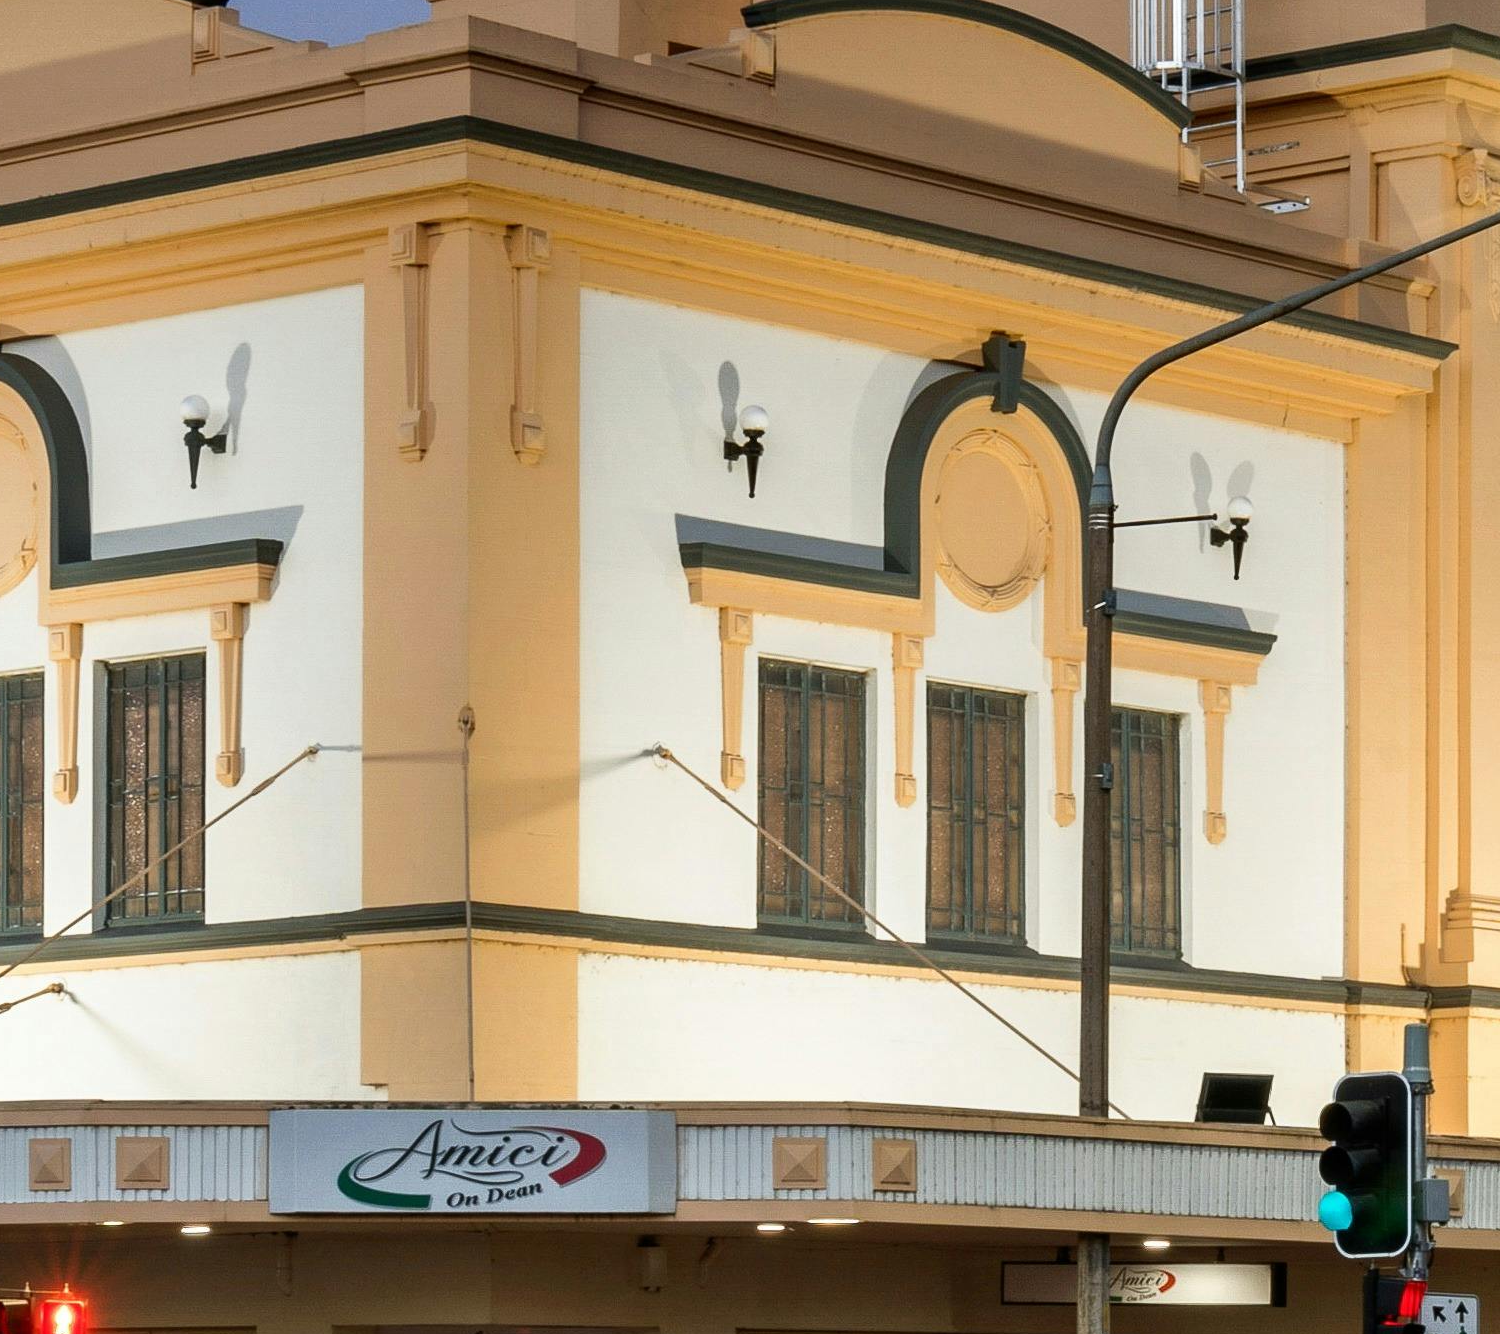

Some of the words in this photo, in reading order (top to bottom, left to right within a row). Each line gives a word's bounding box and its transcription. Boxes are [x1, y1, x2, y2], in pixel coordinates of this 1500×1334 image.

[353, 1119, 569, 1182] Amici
[446, 1192, 479, 1208] On
[487, 1182, 542, 1204] Dean
